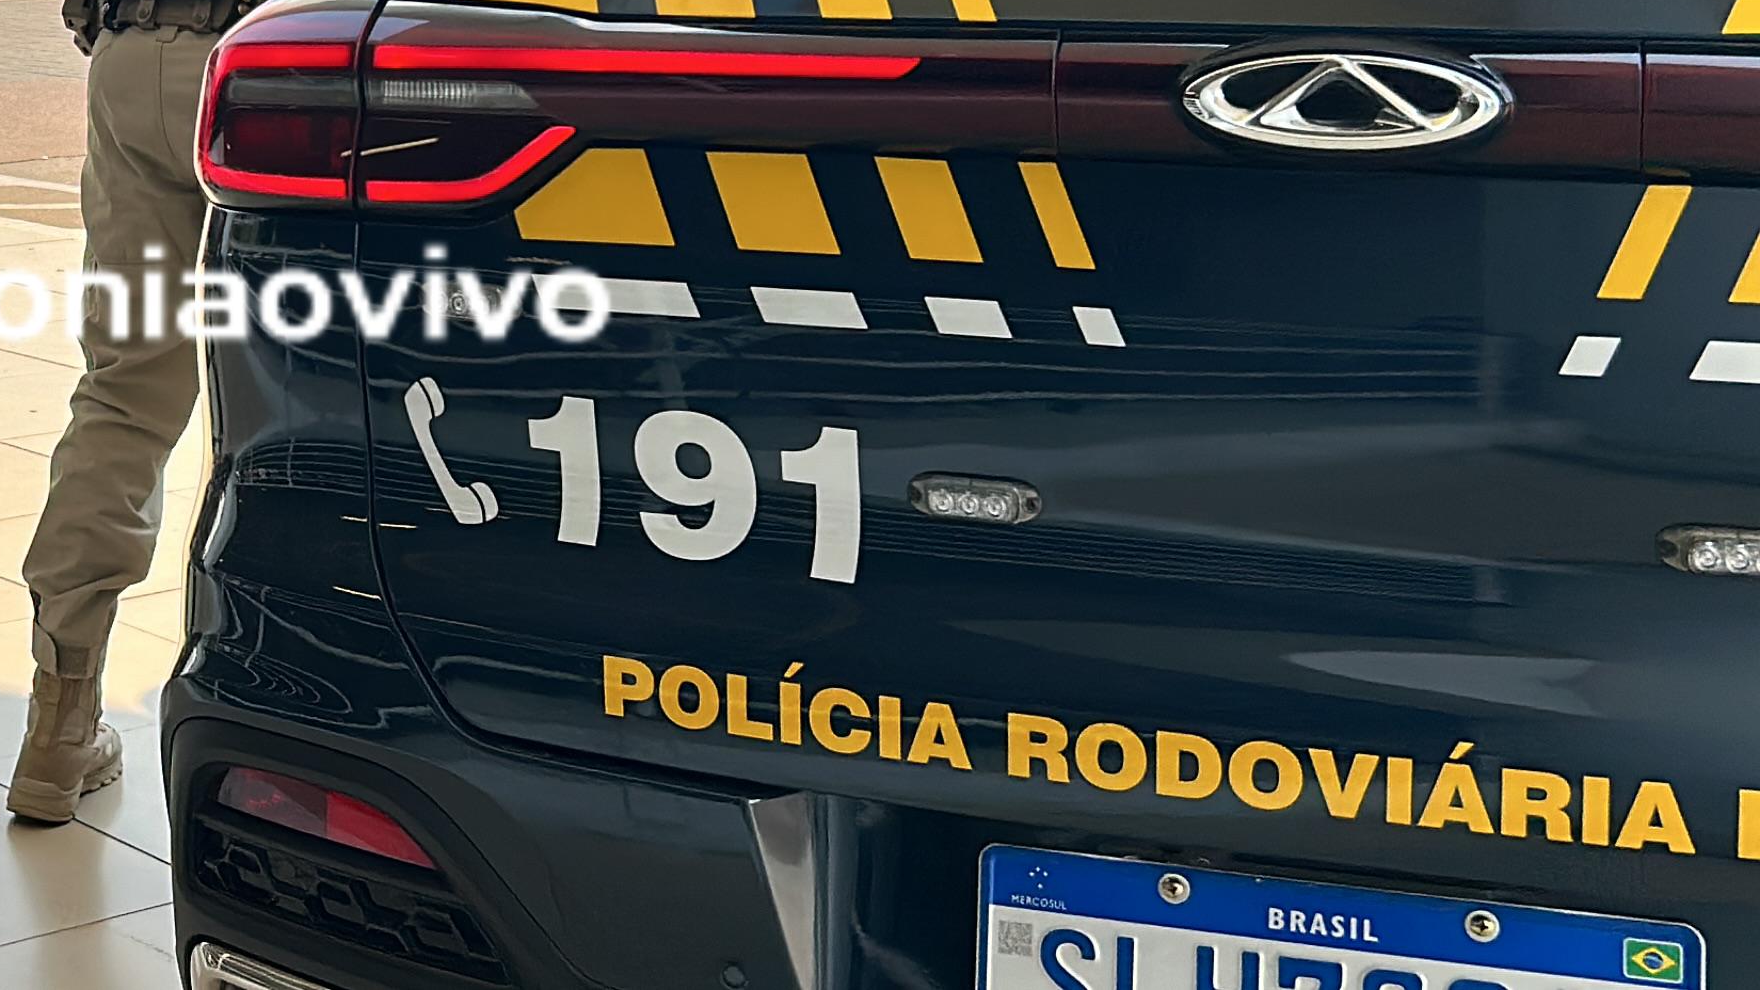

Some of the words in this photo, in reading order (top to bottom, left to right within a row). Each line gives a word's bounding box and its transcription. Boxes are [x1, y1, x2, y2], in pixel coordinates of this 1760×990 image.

[528, 396, 863, 584] 191
[602, 655, 972, 771] POLÍCIA
[1006, 712, 1697, 855] RODOVIÁRIA
[1011, 893, 1067, 911] MERCOSUL
[1267, 906, 1379, 943] BRASIL
